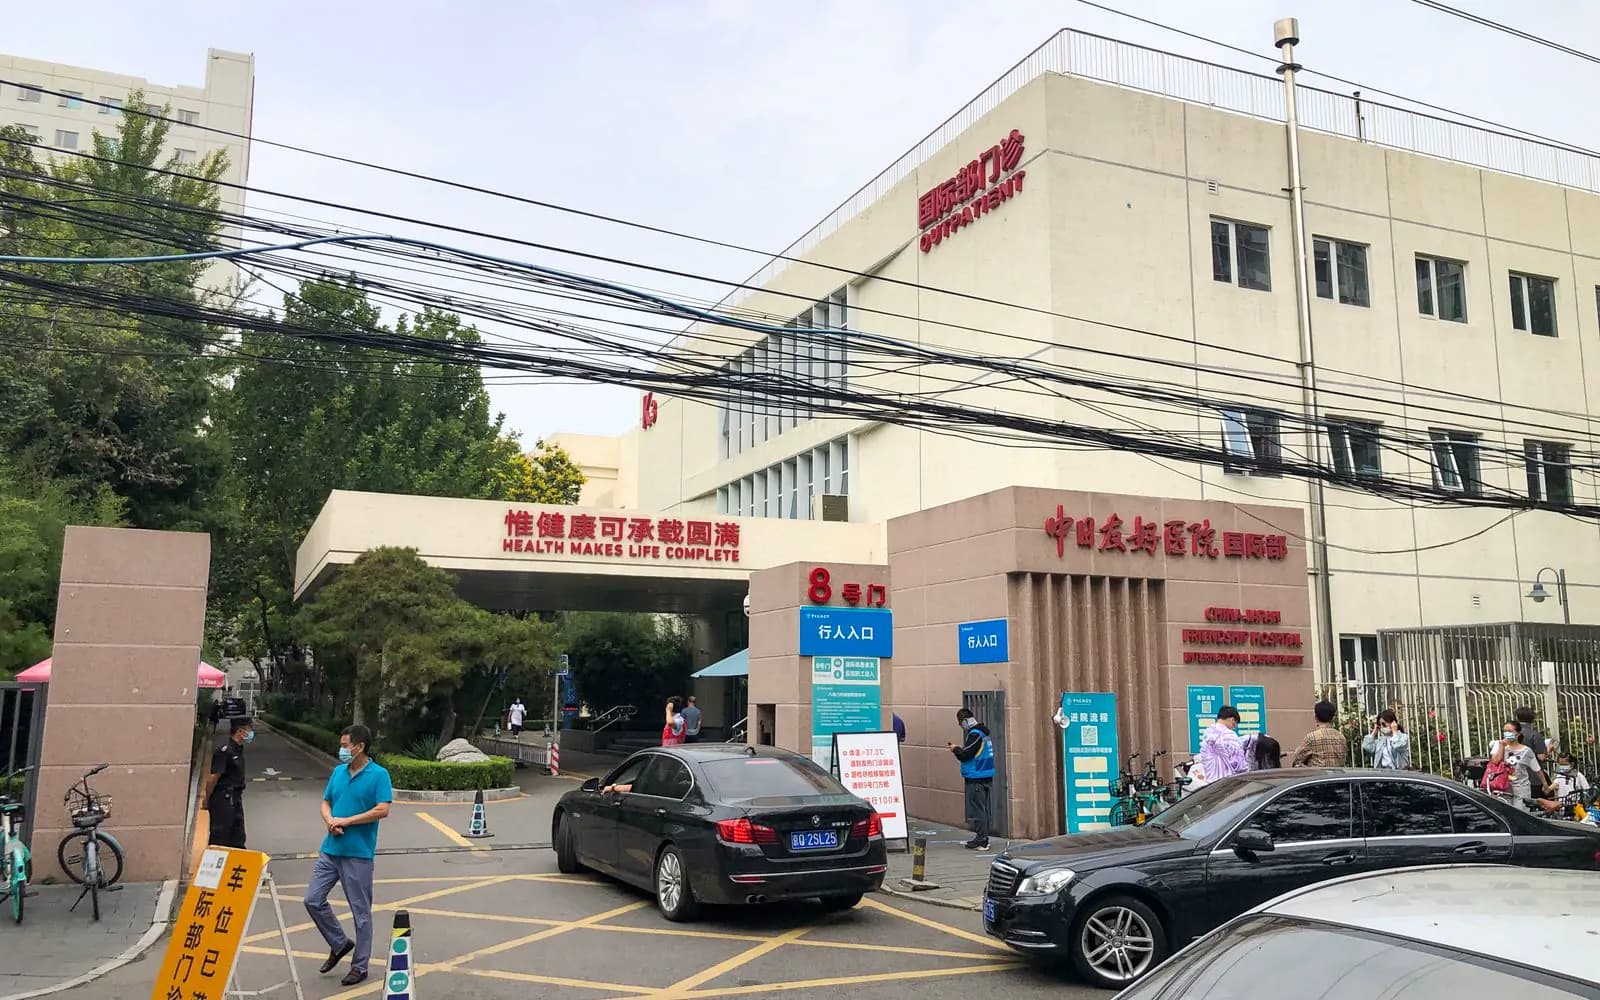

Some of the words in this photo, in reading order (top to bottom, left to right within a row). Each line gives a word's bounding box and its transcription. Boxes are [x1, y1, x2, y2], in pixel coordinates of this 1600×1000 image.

[918, 129, 1025, 230] 国际部门诊
[920, 170, 1026, 253] OUTPATIENT
[504, 509, 741, 548] 惟健康可承载圆满
[503, 539, 564, 554] HEALTH
[570, 542, 623, 557] MAKES
[628, 544, 660, 559] LIFE
[665, 546, 740, 562] COMPLETE
[818, 624, 874, 641] 行人入口
[967, 634, 997, 649] 行人入口
[1182, 629, 1249, 645] FRIENDSHIP
[1250, 631, 1301, 648] HOSPITAL
